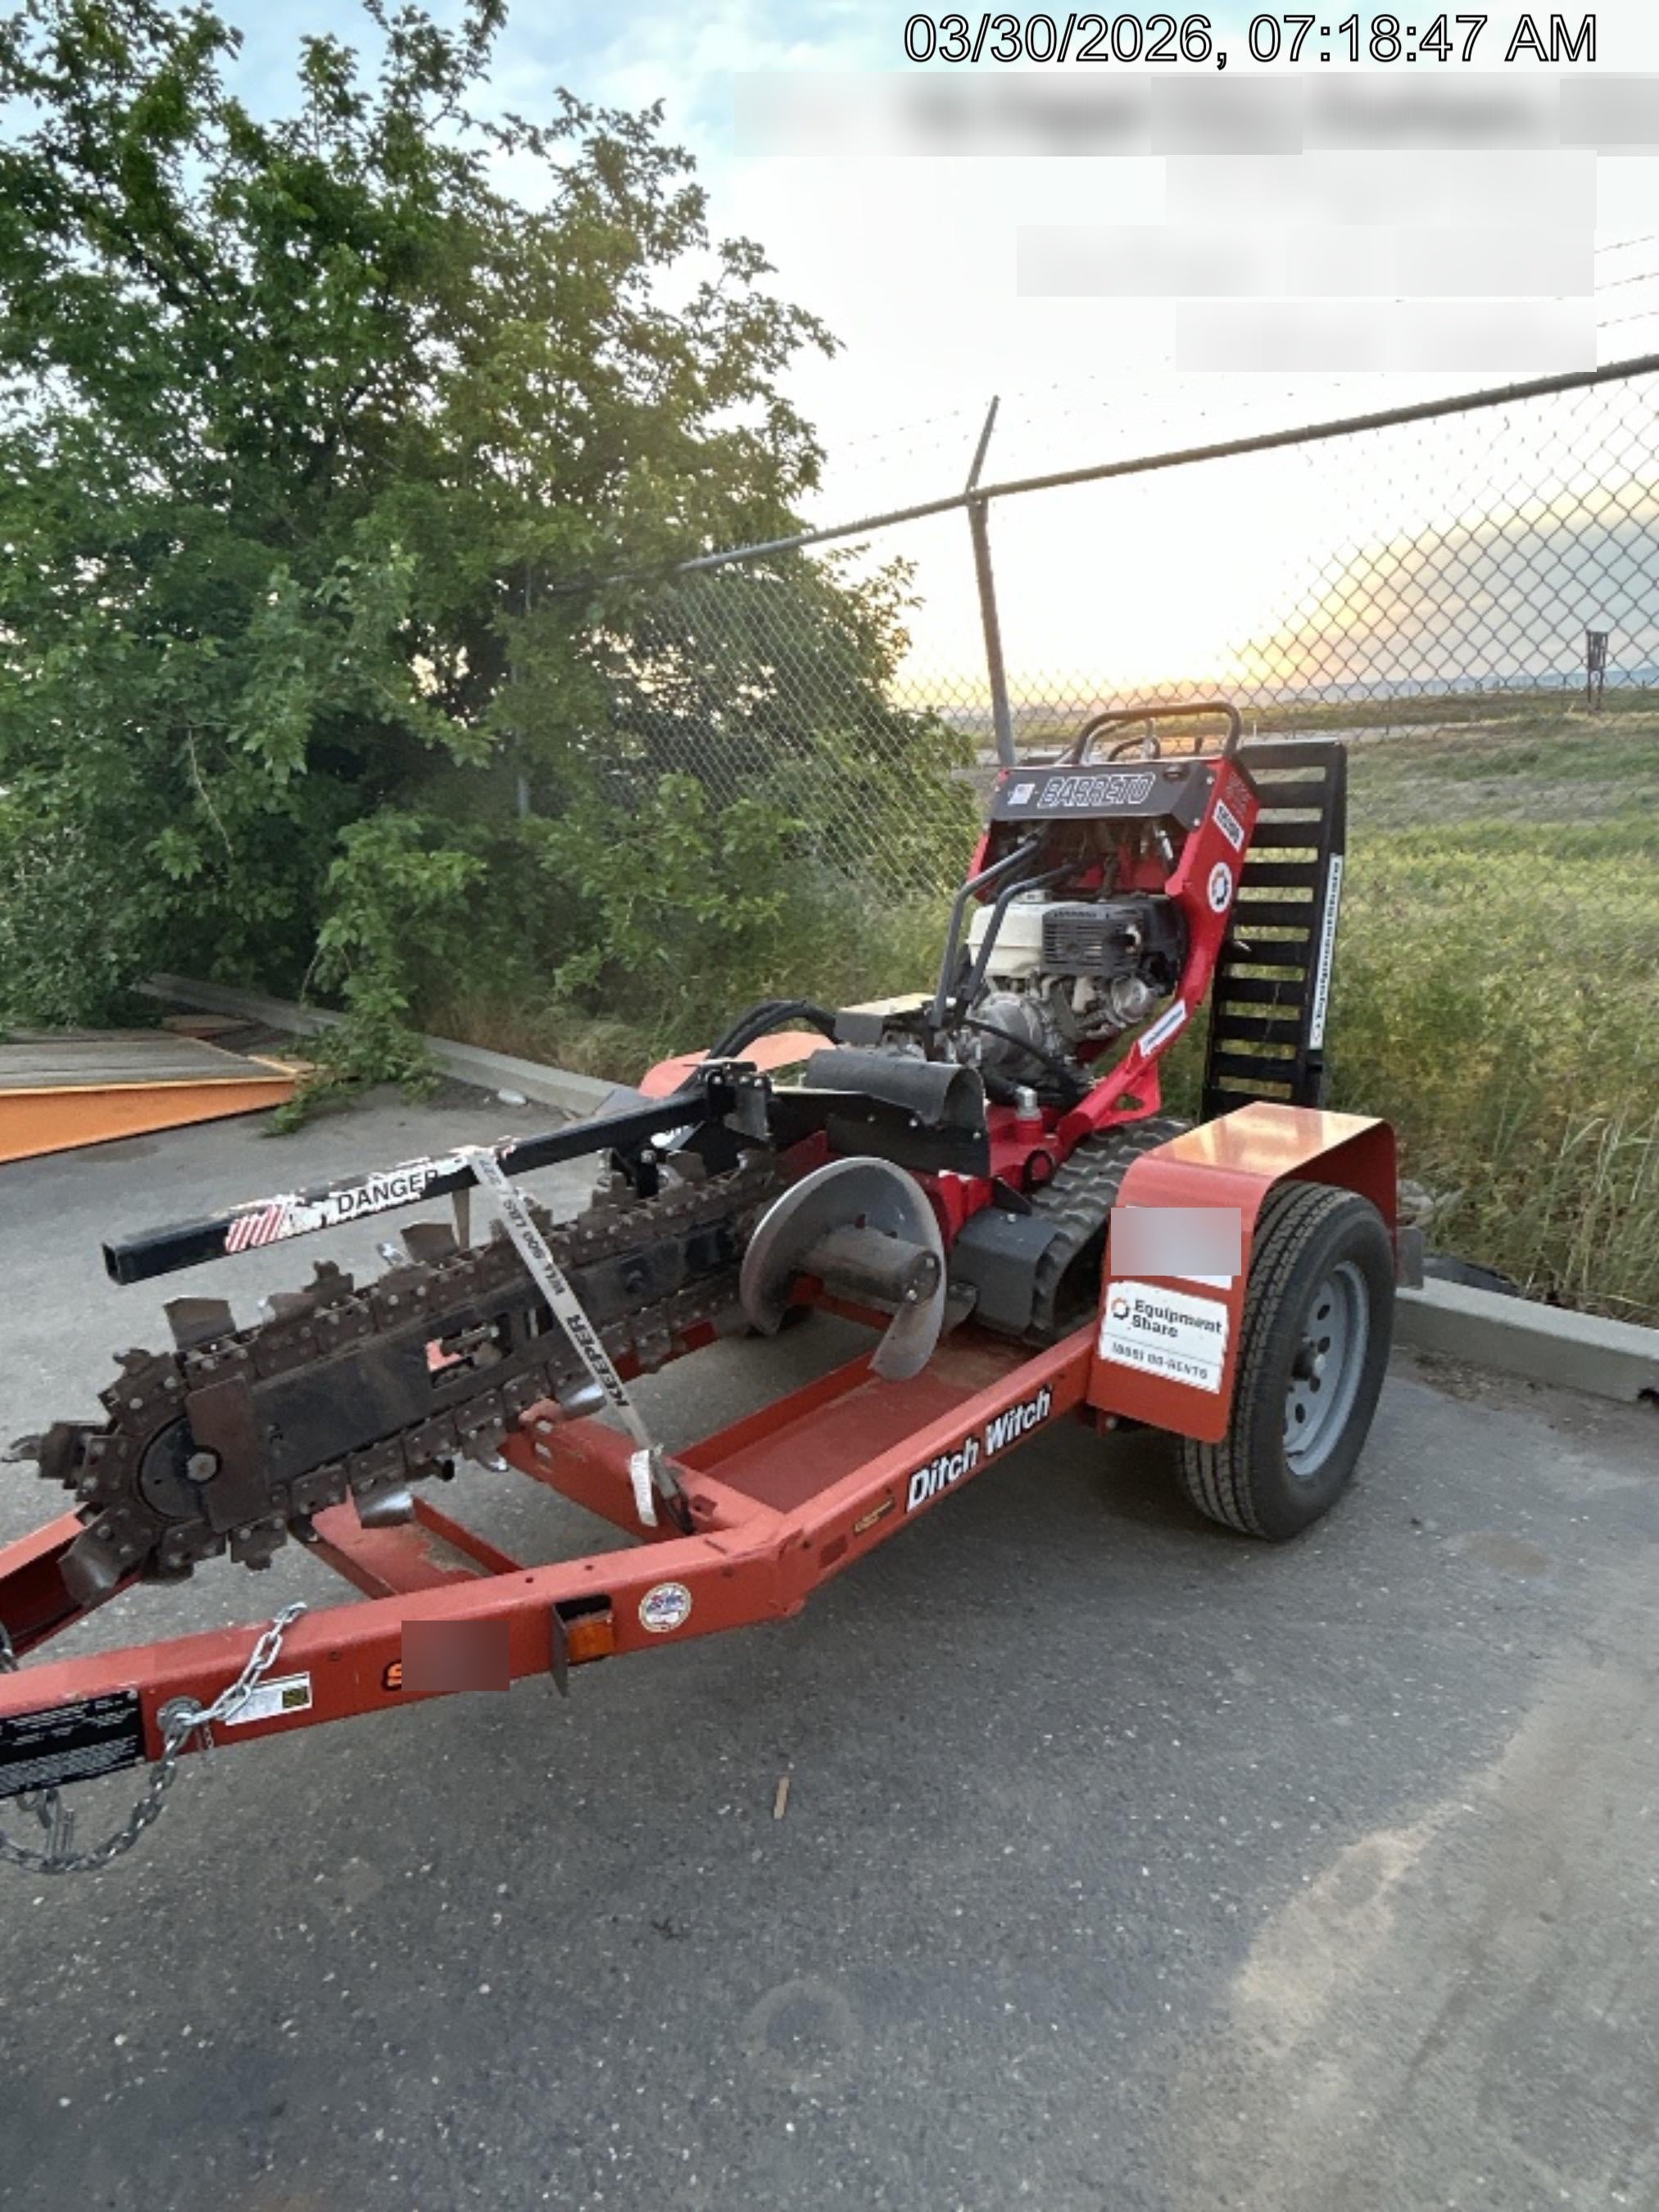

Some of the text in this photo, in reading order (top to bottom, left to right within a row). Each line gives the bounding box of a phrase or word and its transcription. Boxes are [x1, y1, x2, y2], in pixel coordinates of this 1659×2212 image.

[1131, 1314, 1179, 1338] Share
[1134, 1299, 1222, 1335] Equipment
[566, 1314, 629, 1406] KEEPER
[907, 1387, 1051, 1512] Ditch Witch
